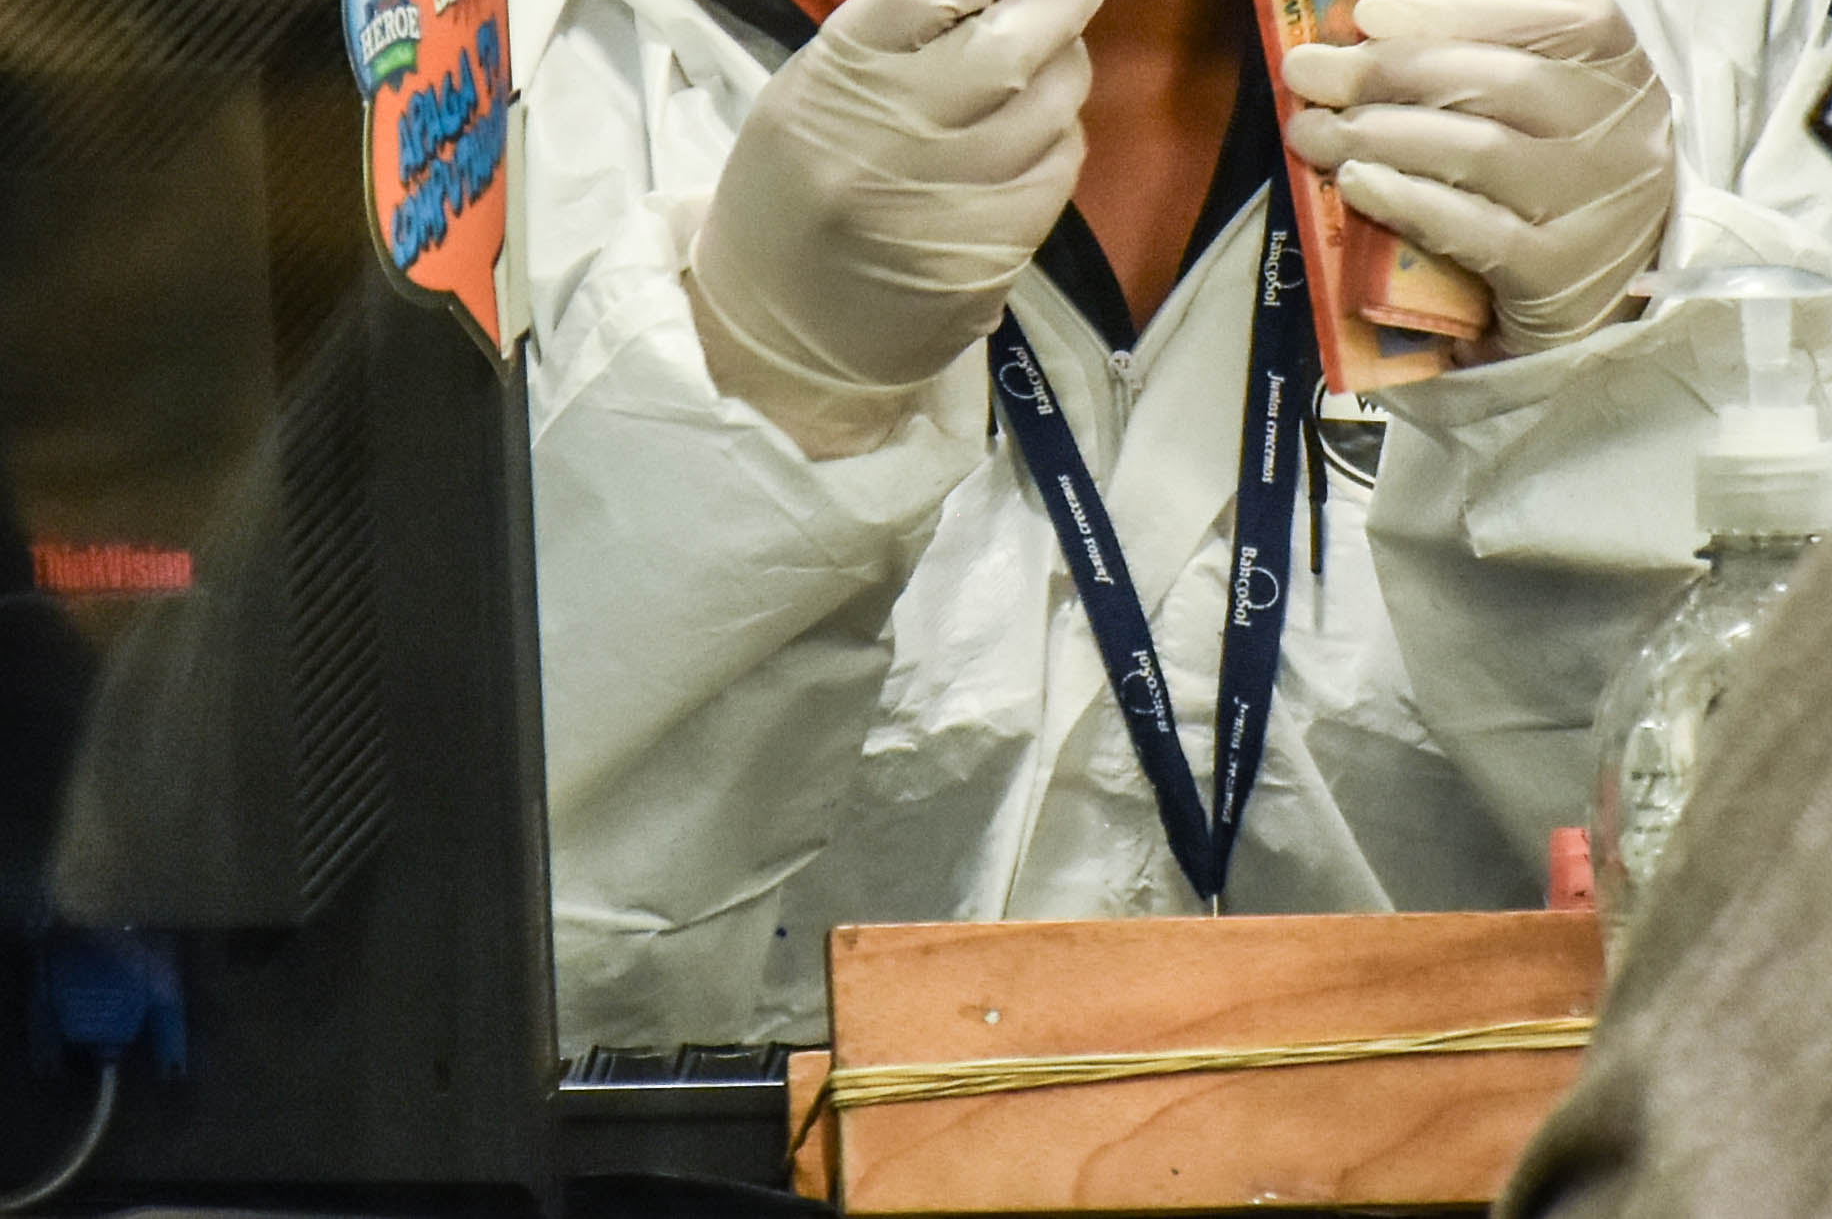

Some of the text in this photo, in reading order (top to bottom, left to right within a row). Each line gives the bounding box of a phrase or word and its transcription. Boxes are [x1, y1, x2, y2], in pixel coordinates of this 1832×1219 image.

[1263, 230, 1288, 307] BancoSol
[1008, 346, 1054, 415] BancoSol
[1261, 370, 1286, 485] Juntos crecemos
[1056, 473, 1115, 585] Juntos crecemos
[1233, 545, 1258, 627] BancoSol
